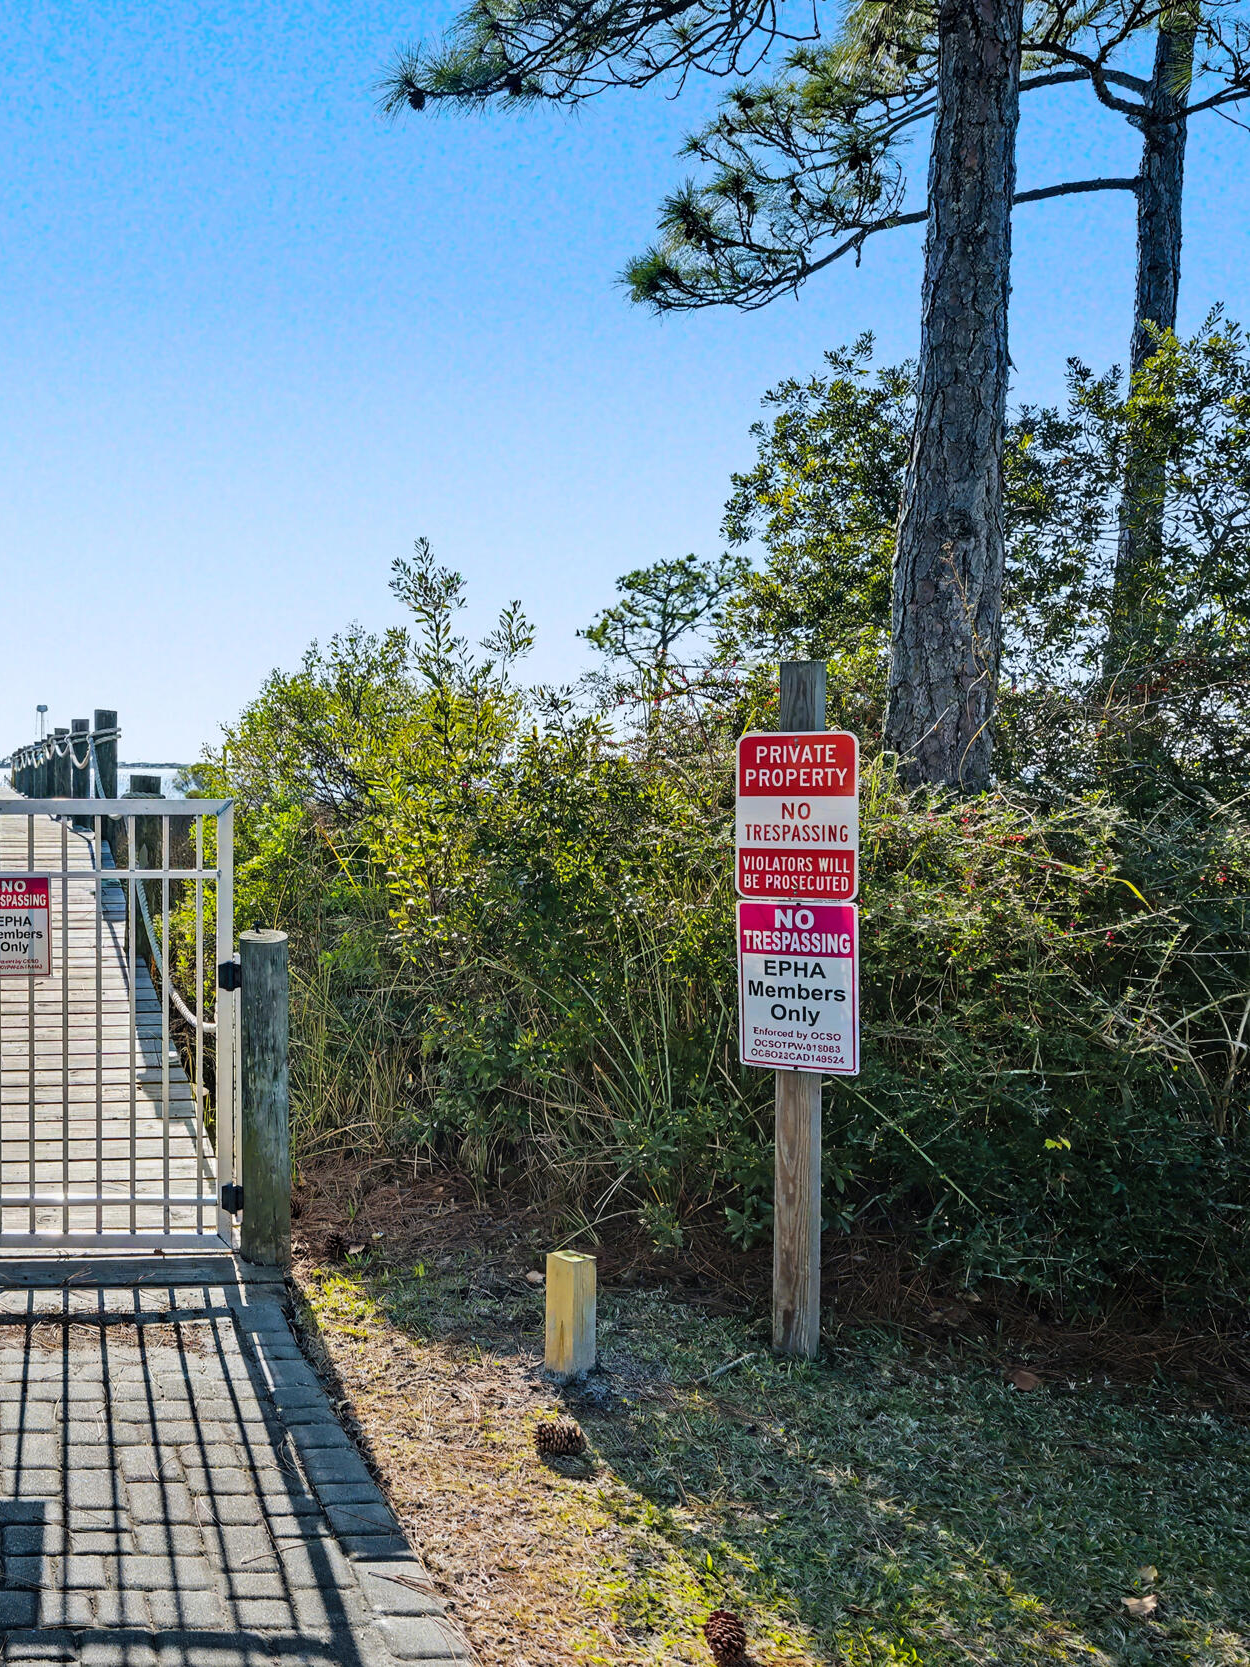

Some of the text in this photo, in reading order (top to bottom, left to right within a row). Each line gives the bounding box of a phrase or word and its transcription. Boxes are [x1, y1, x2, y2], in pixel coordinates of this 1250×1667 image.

[756, 745, 836, 764] PRIVATE
[745, 768, 848, 787] PROPERTY
[782, 803, 811, 820] NO
[745, 824, 848, 842] TRESPASSING
[743, 856, 850, 873] VIOLATORS WILL
[1, 881, 26, 892] NO
[743, 874, 849, 892] BE PROSECUTED
[774, 909, 815, 929] NO
[1, 942, 29, 954] Only
[743, 930, 851, 954] TRESPASSING
[764, 960, 826, 979] EPHA
[748, 980, 846, 1001] Members
[770, 1004, 820, 1026] Only
[753, 1026, 841, 1041] Enforced by OCSO
